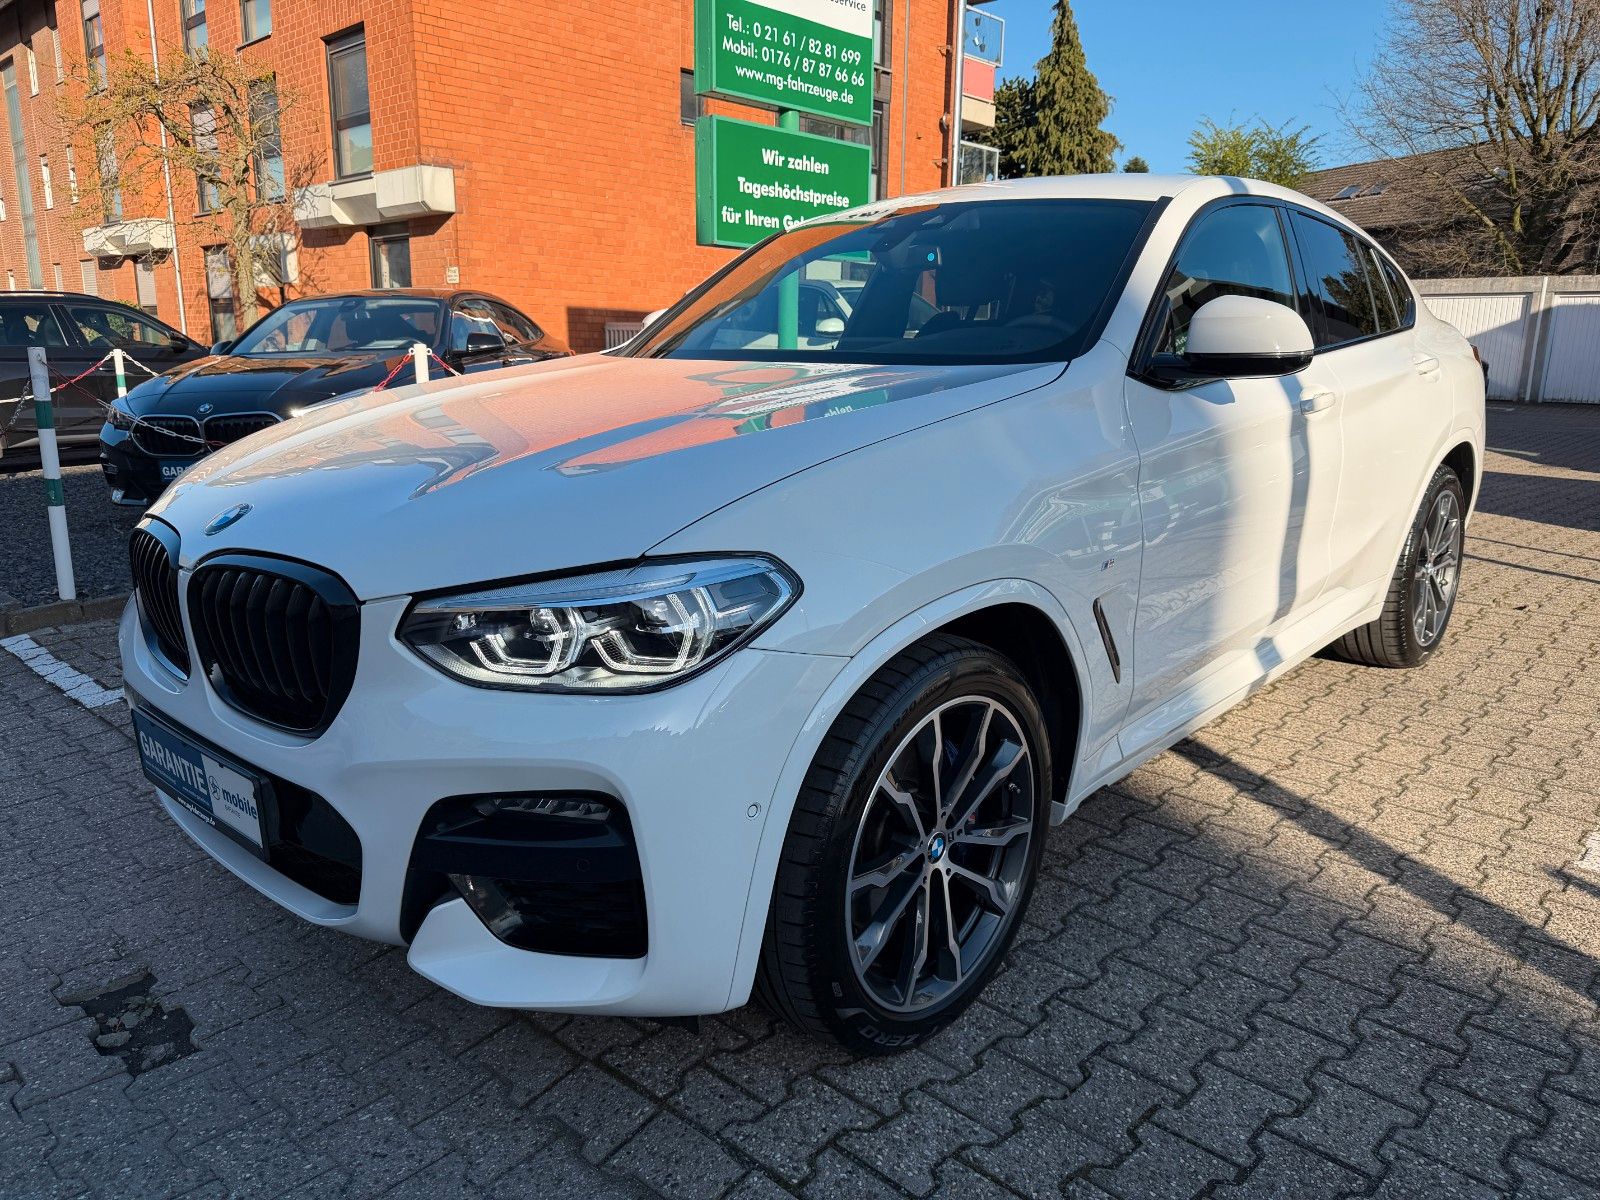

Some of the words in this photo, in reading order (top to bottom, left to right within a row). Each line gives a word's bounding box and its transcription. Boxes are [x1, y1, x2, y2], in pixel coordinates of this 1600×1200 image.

[831, 0, 867, 11] service
[726, 13, 750, 35] Tel.:
[753, 22, 762, 38] 0
[764, 25, 778, 43] 21
[782, 31, 796, 47] 61
[799, 36, 807, 51] /
[808, 38, 822, 55] 82
[824, 43, 837, 60] 81
[840, 48, 861, 66] 699
[722, 36, 758, 60] Mobil:
[761, 47, 791, 68] 0176
[793, 56, 800, 71] /
[802, 58, 816, 74] 87
[818, 62, 832, 79] 87
[834, 66, 849, 83] 66
[851, 72, 865, 87] 66
[735, 65, 854, 105] www.mg-fahrzeuge.de
[761, 148, 785, 167] Wir
[787, 155, 829, 175] zahlen
[737, 176, 850, 208] Tageshöchstpreise
[721, 206, 742, 224] für
[745, 209, 780, 229] Ihren
[139, 730, 208, 796] GARANTIE
[221, 787, 258, 820] mobile
